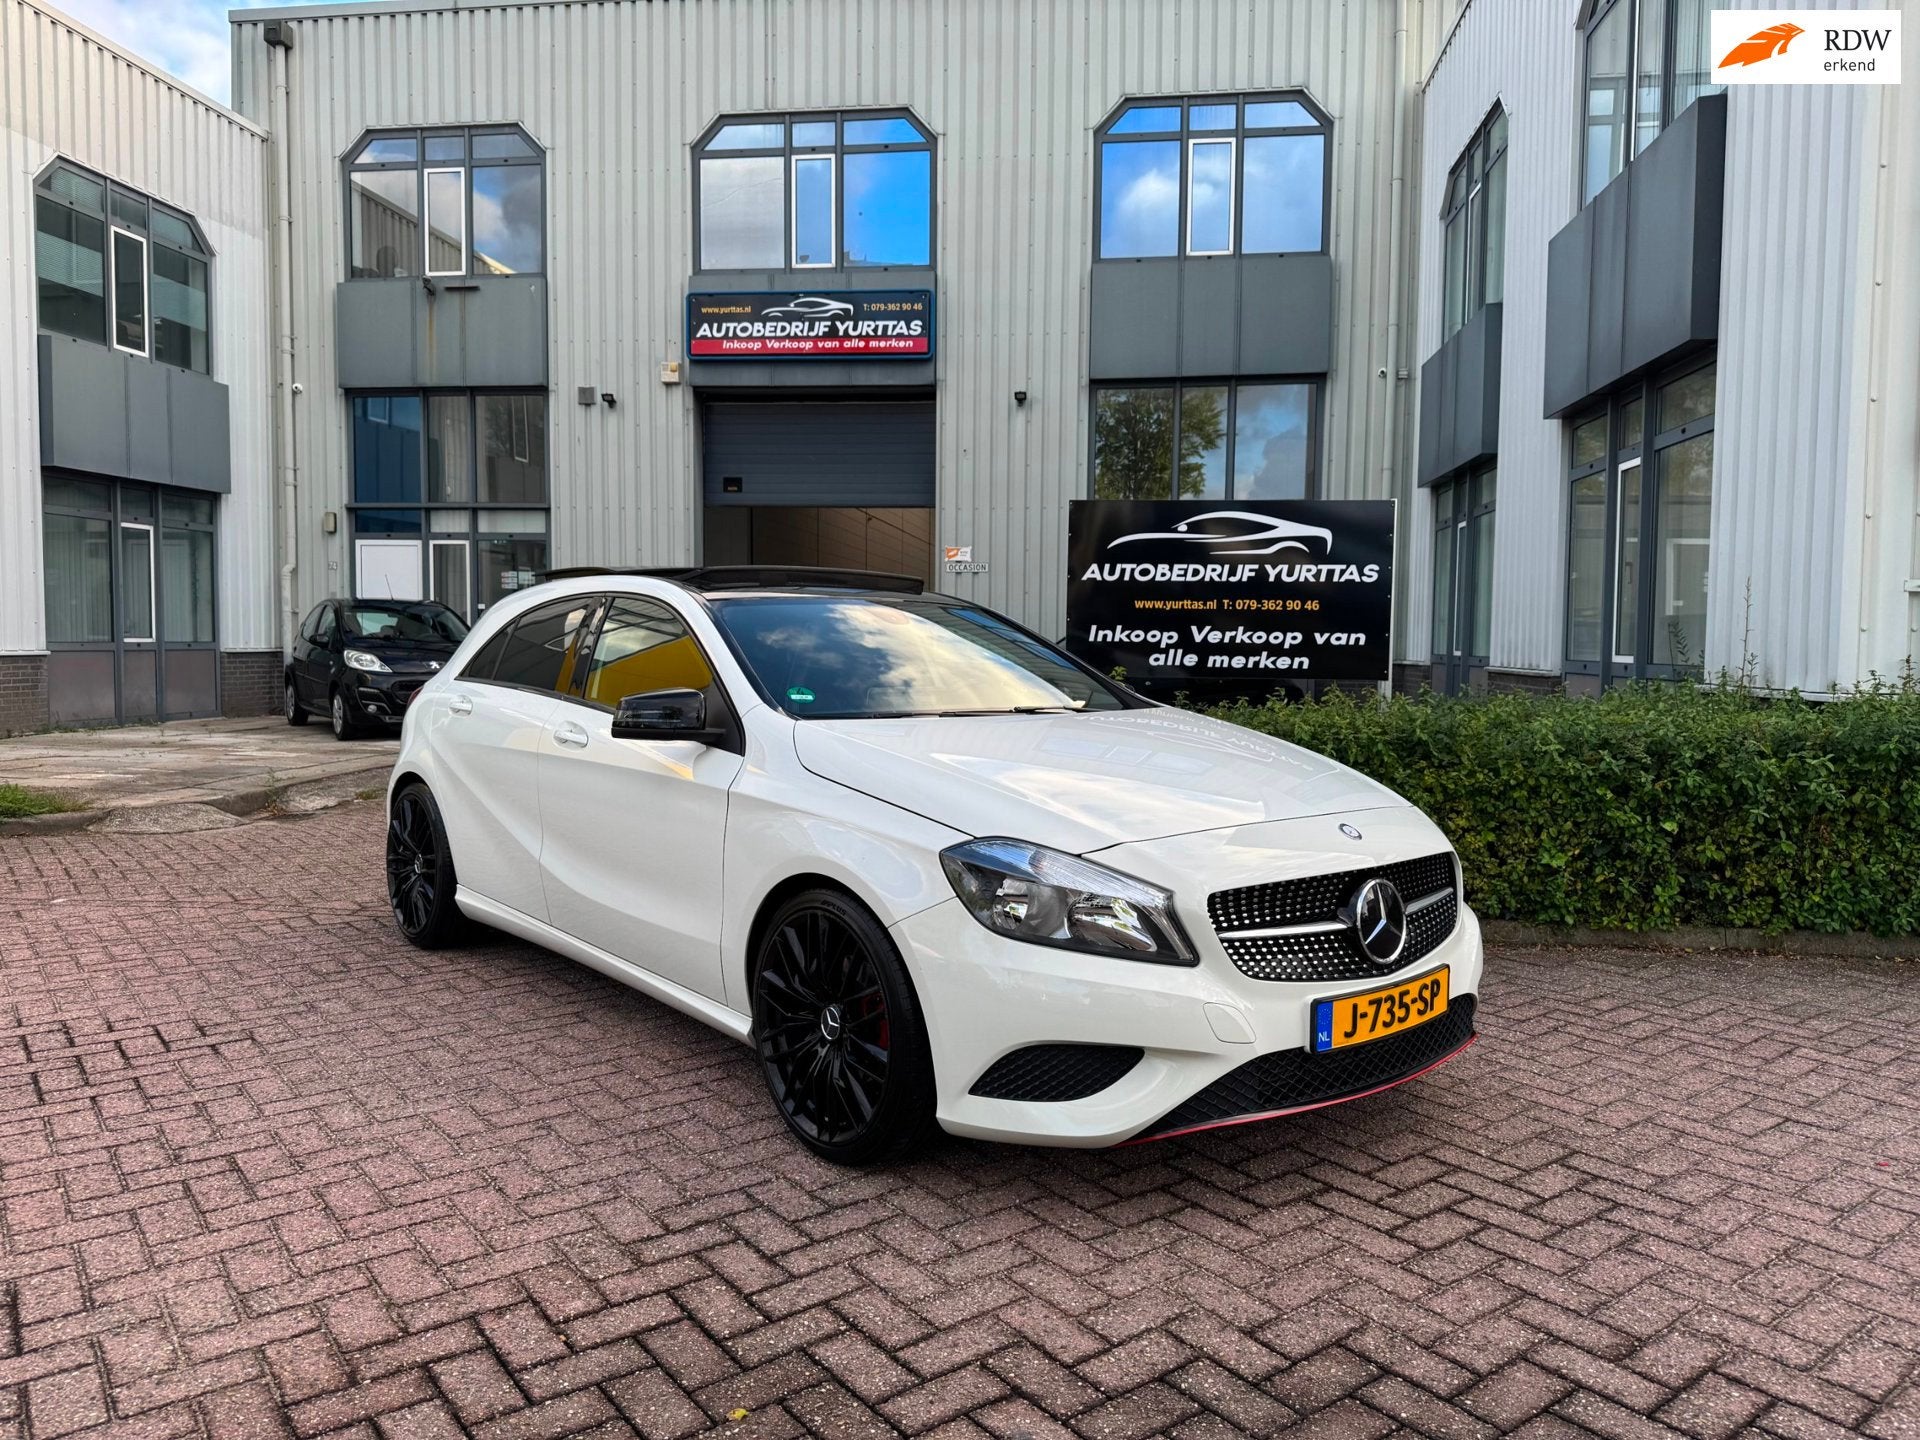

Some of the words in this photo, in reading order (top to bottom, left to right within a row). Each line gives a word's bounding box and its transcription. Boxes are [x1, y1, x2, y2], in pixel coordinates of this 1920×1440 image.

[701, 305, 752, 315] www.yurttas.nl
[863, 303, 870, 311] T:
[871, 303, 901, 311] 079-362
[902, 303, 912, 311] 90
[913, 303, 923, 311] 46
[696, 321, 831, 338] AUTOBEDRIJF
[835, 320, 923, 336] YURTTAS
[723, 340, 762, 350] Inkoop
[766, 339, 814, 350] Verkoop
[843, 339, 865, 348] alle
[869, 338, 913, 348] merken
[1081, 563, 1259, 582] AUTOBEDRIJF
[1265, 564, 1379, 583] YURTTAS
[1135, 599, 1217, 611] www.yurttas.nl
[1223, 599, 1233, 610] T:
[1235, 599, 1284, 610] 079-362
[1286, 600, 1301, 611] 90
[1304, 600, 1320, 611] 46
[1088, 625, 1179, 647] Inkoop
[1190, 626, 1303, 648] Verkoop
[1314, 630, 1366, 646] van
[1148, 649, 1198, 667] alle
[1207, 652, 1309, 669] merken
[1344, 978, 1441, 1038] J-735-SP
[1318, 1031, 1330, 1043] NL
